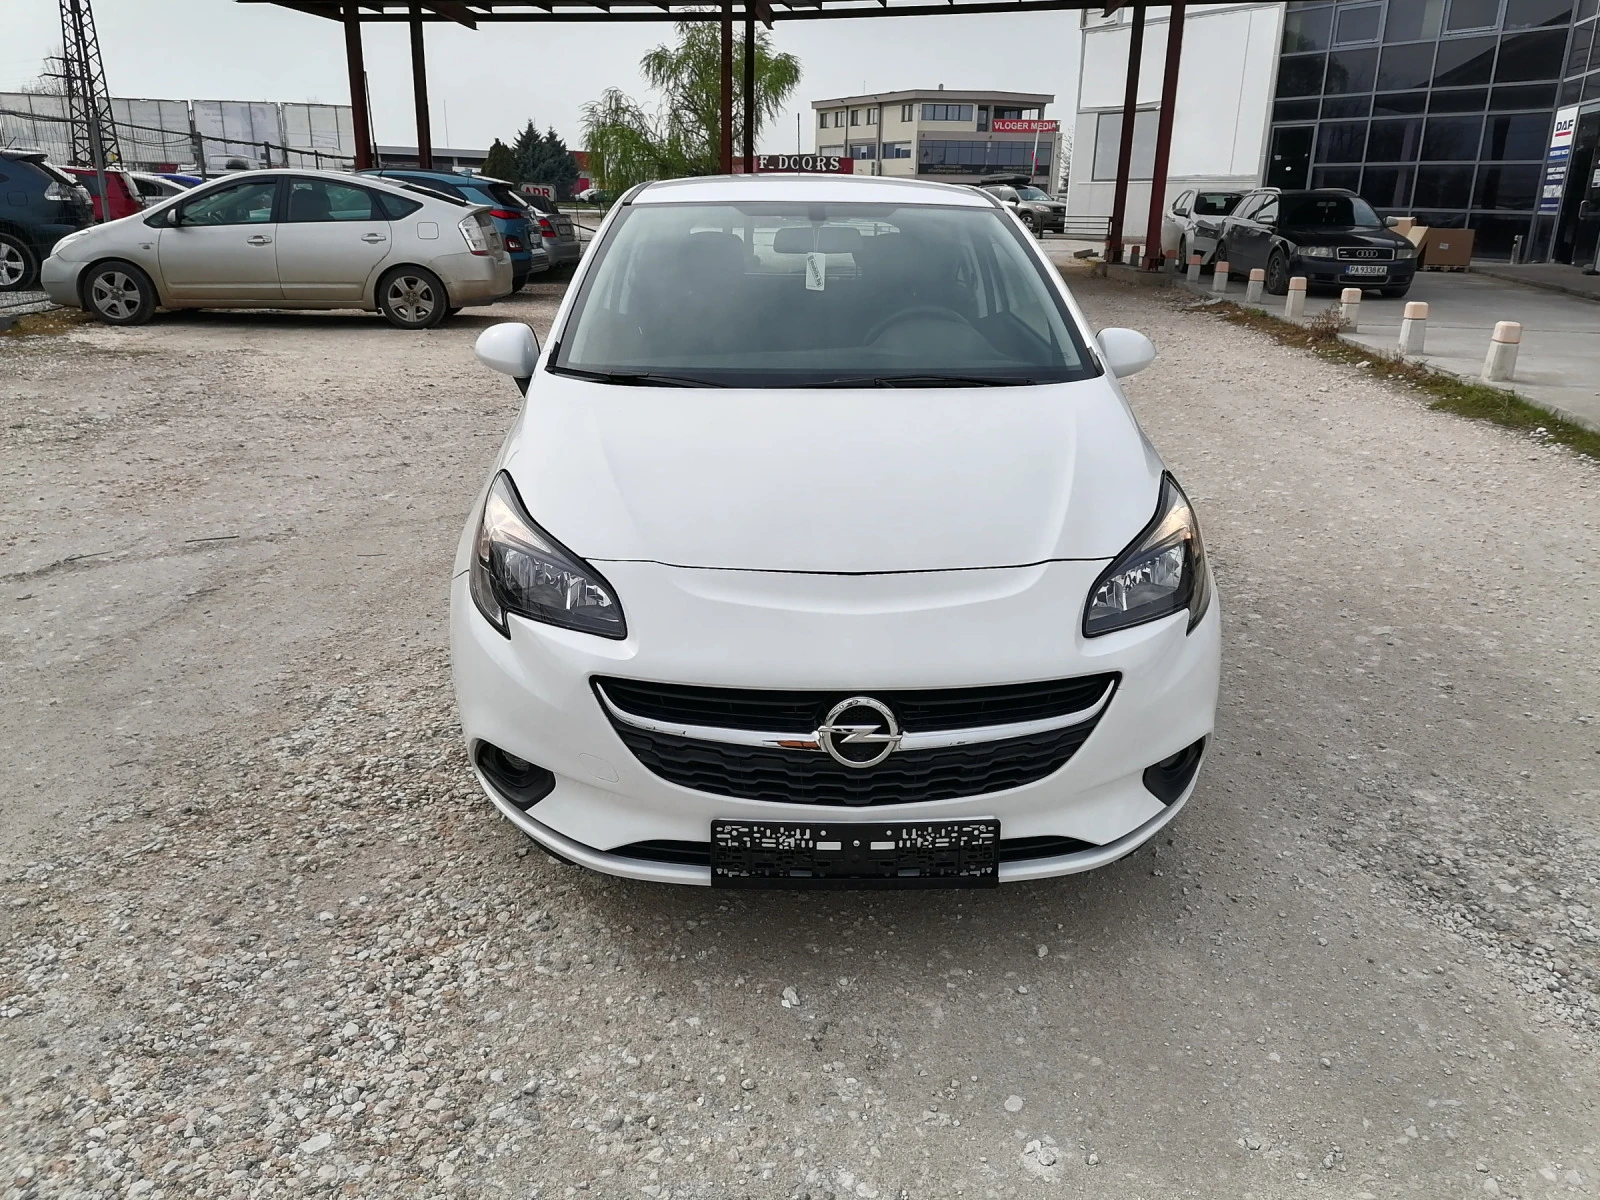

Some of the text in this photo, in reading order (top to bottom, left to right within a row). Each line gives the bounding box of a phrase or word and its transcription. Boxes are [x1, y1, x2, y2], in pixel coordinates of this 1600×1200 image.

[994, 121, 1056, 131] VLOGER MEDIA
[1556, 119, 1574, 131] DAF
[525, 186, 551, 198] ADR
